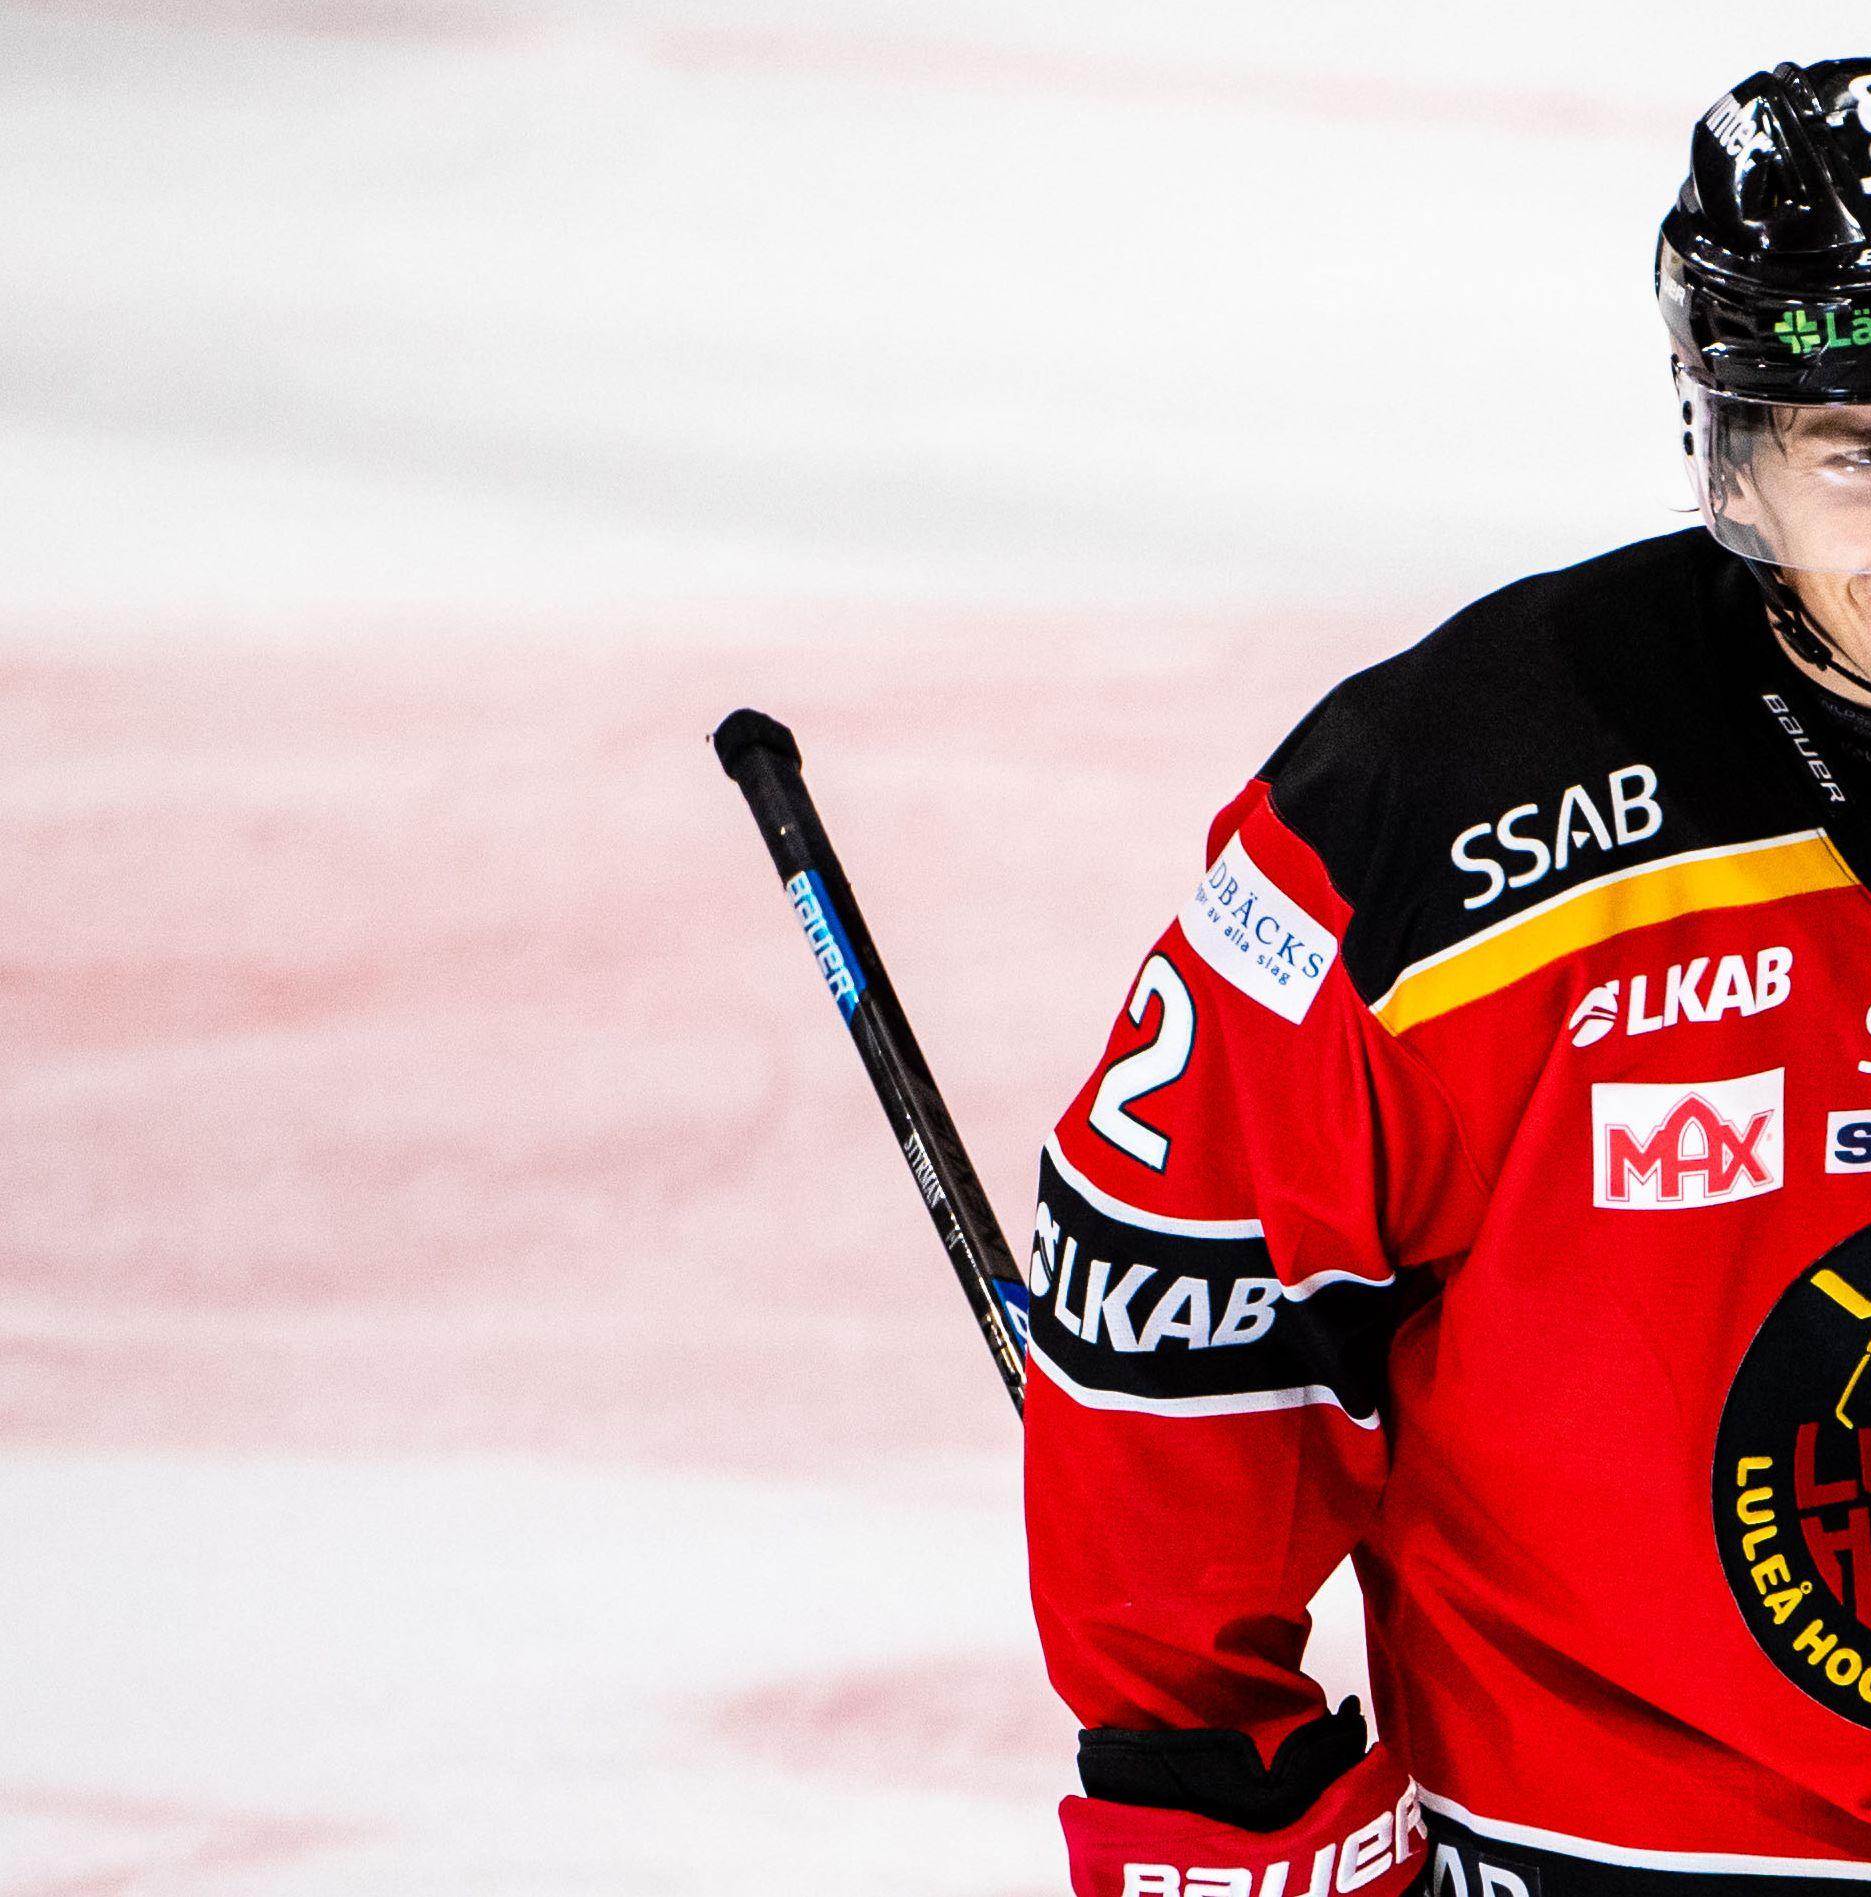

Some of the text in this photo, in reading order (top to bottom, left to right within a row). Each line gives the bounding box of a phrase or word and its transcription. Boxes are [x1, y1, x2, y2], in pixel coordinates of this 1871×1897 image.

[1451, 763, 1663, 910] SSAB
[1224, 925, 1250, 953] alla
[1256, 954, 1291, 986] slag
[1626, 946, 1794, 1038] LKAB
[1605, 1091, 1775, 1203] MAX
[1054, 1236, 1284, 1353] LKAB
[1737, 1455, 1813, 1625] LULEÅ
